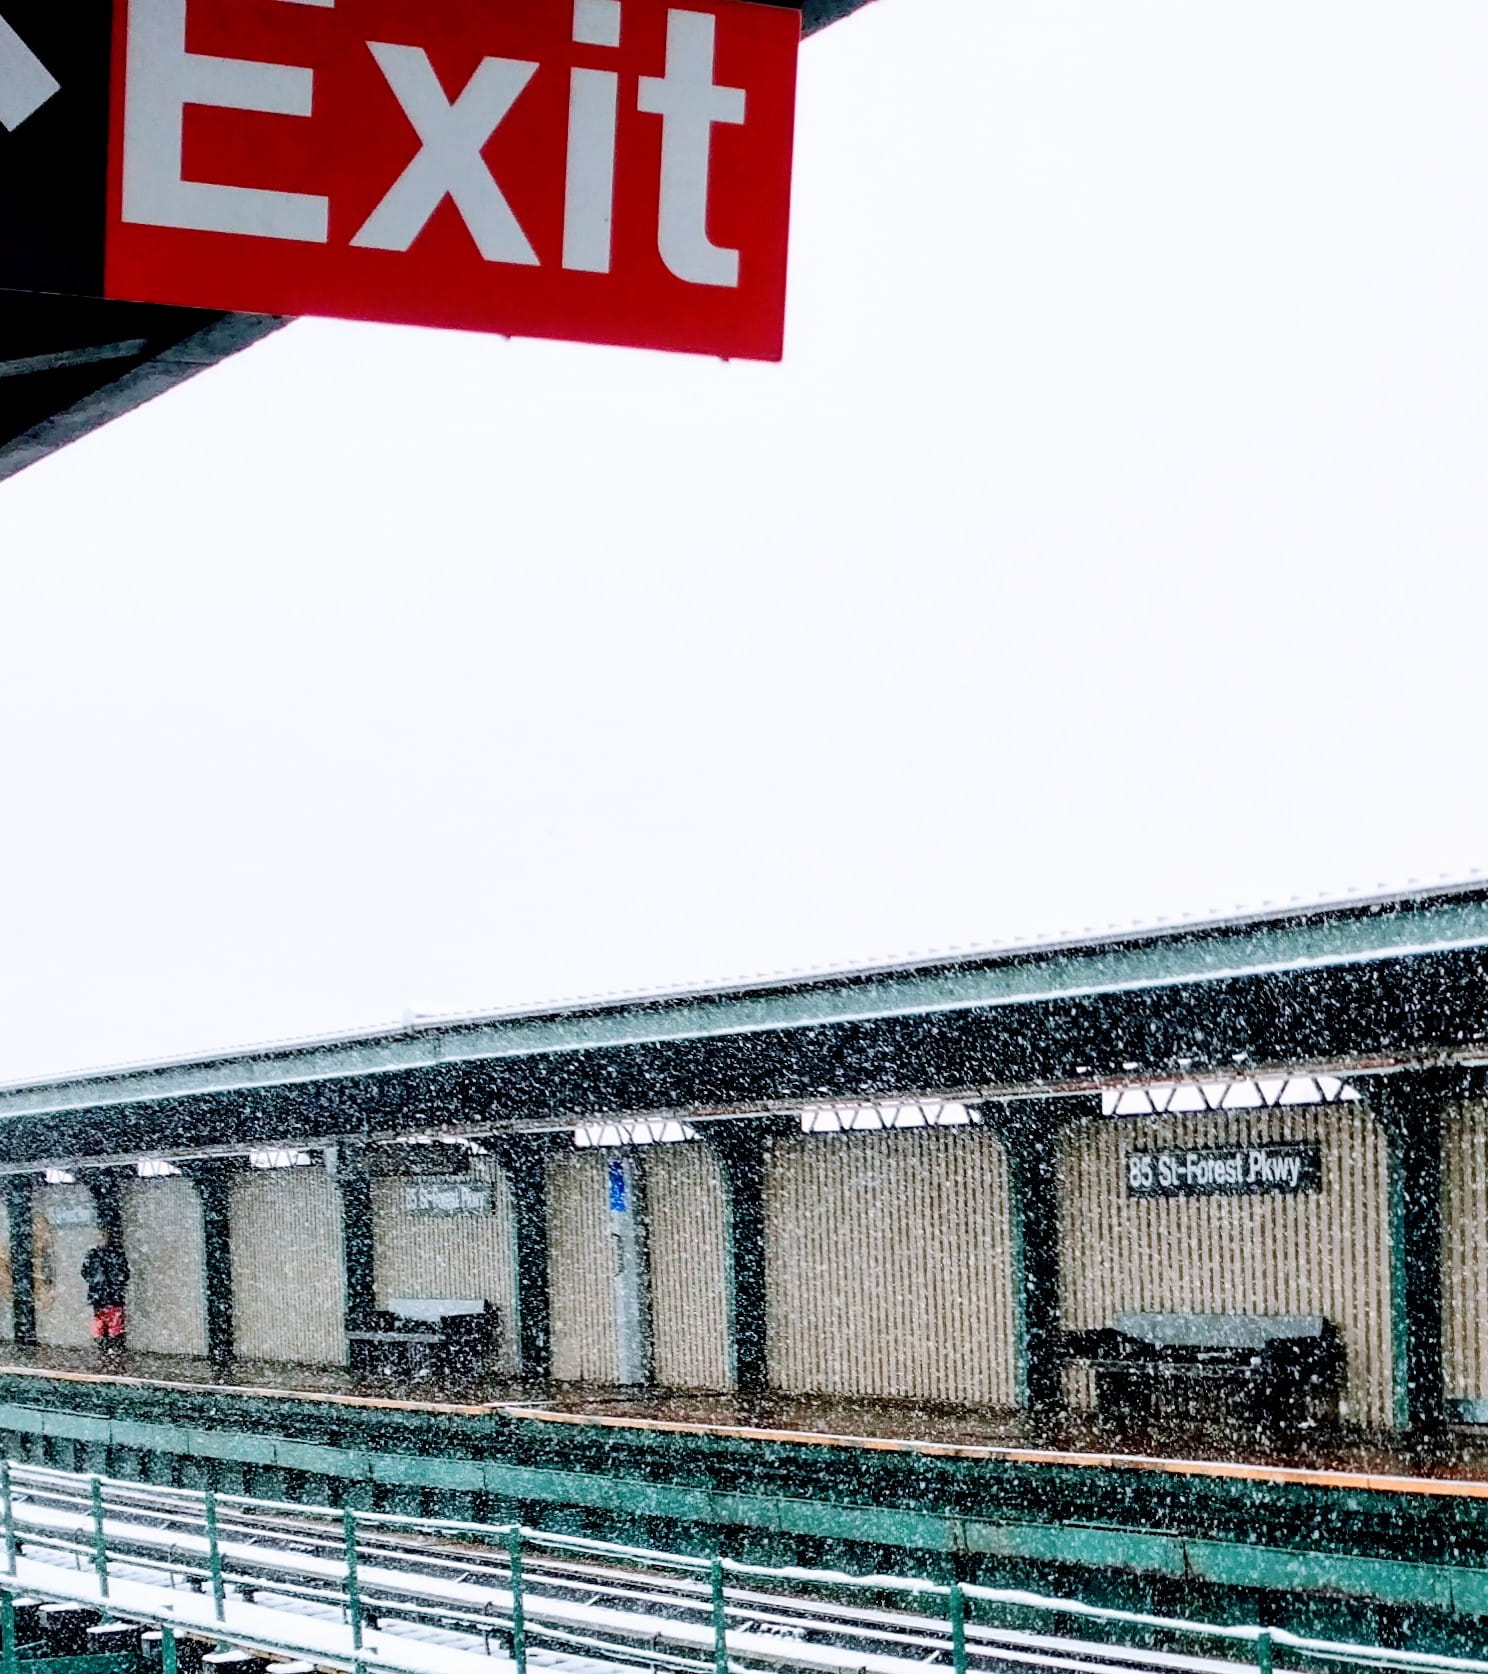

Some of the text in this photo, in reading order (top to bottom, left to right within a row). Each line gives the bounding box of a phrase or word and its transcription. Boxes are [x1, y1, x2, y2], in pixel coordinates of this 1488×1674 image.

[121, 0, 745, 287] Exit
[1129, 1150, 1300, 1187] 85 St-Forest Pkwy
